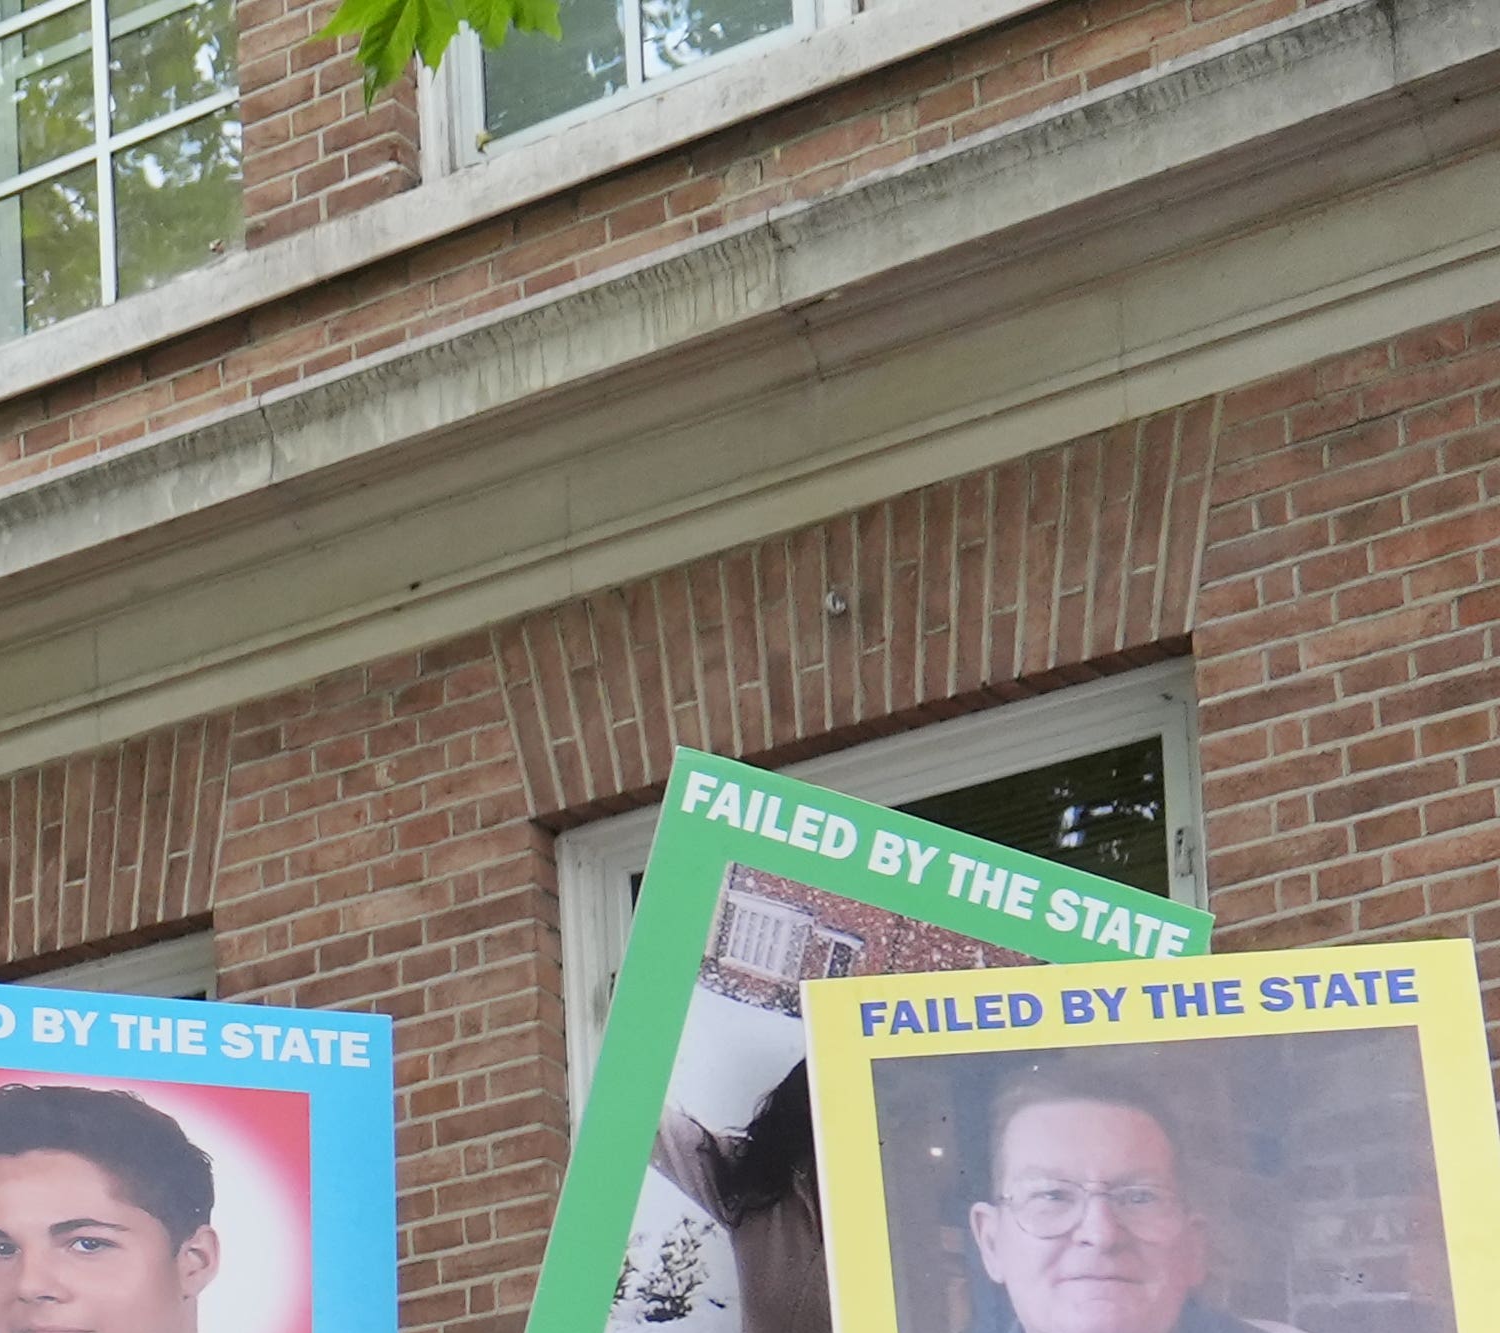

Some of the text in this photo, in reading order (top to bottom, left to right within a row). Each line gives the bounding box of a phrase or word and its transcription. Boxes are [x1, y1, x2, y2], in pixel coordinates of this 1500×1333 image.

[32, 1006, 98, 1046] BY
[110, 1013, 207, 1056] THE
[220, 1022, 370, 1068] STATE
